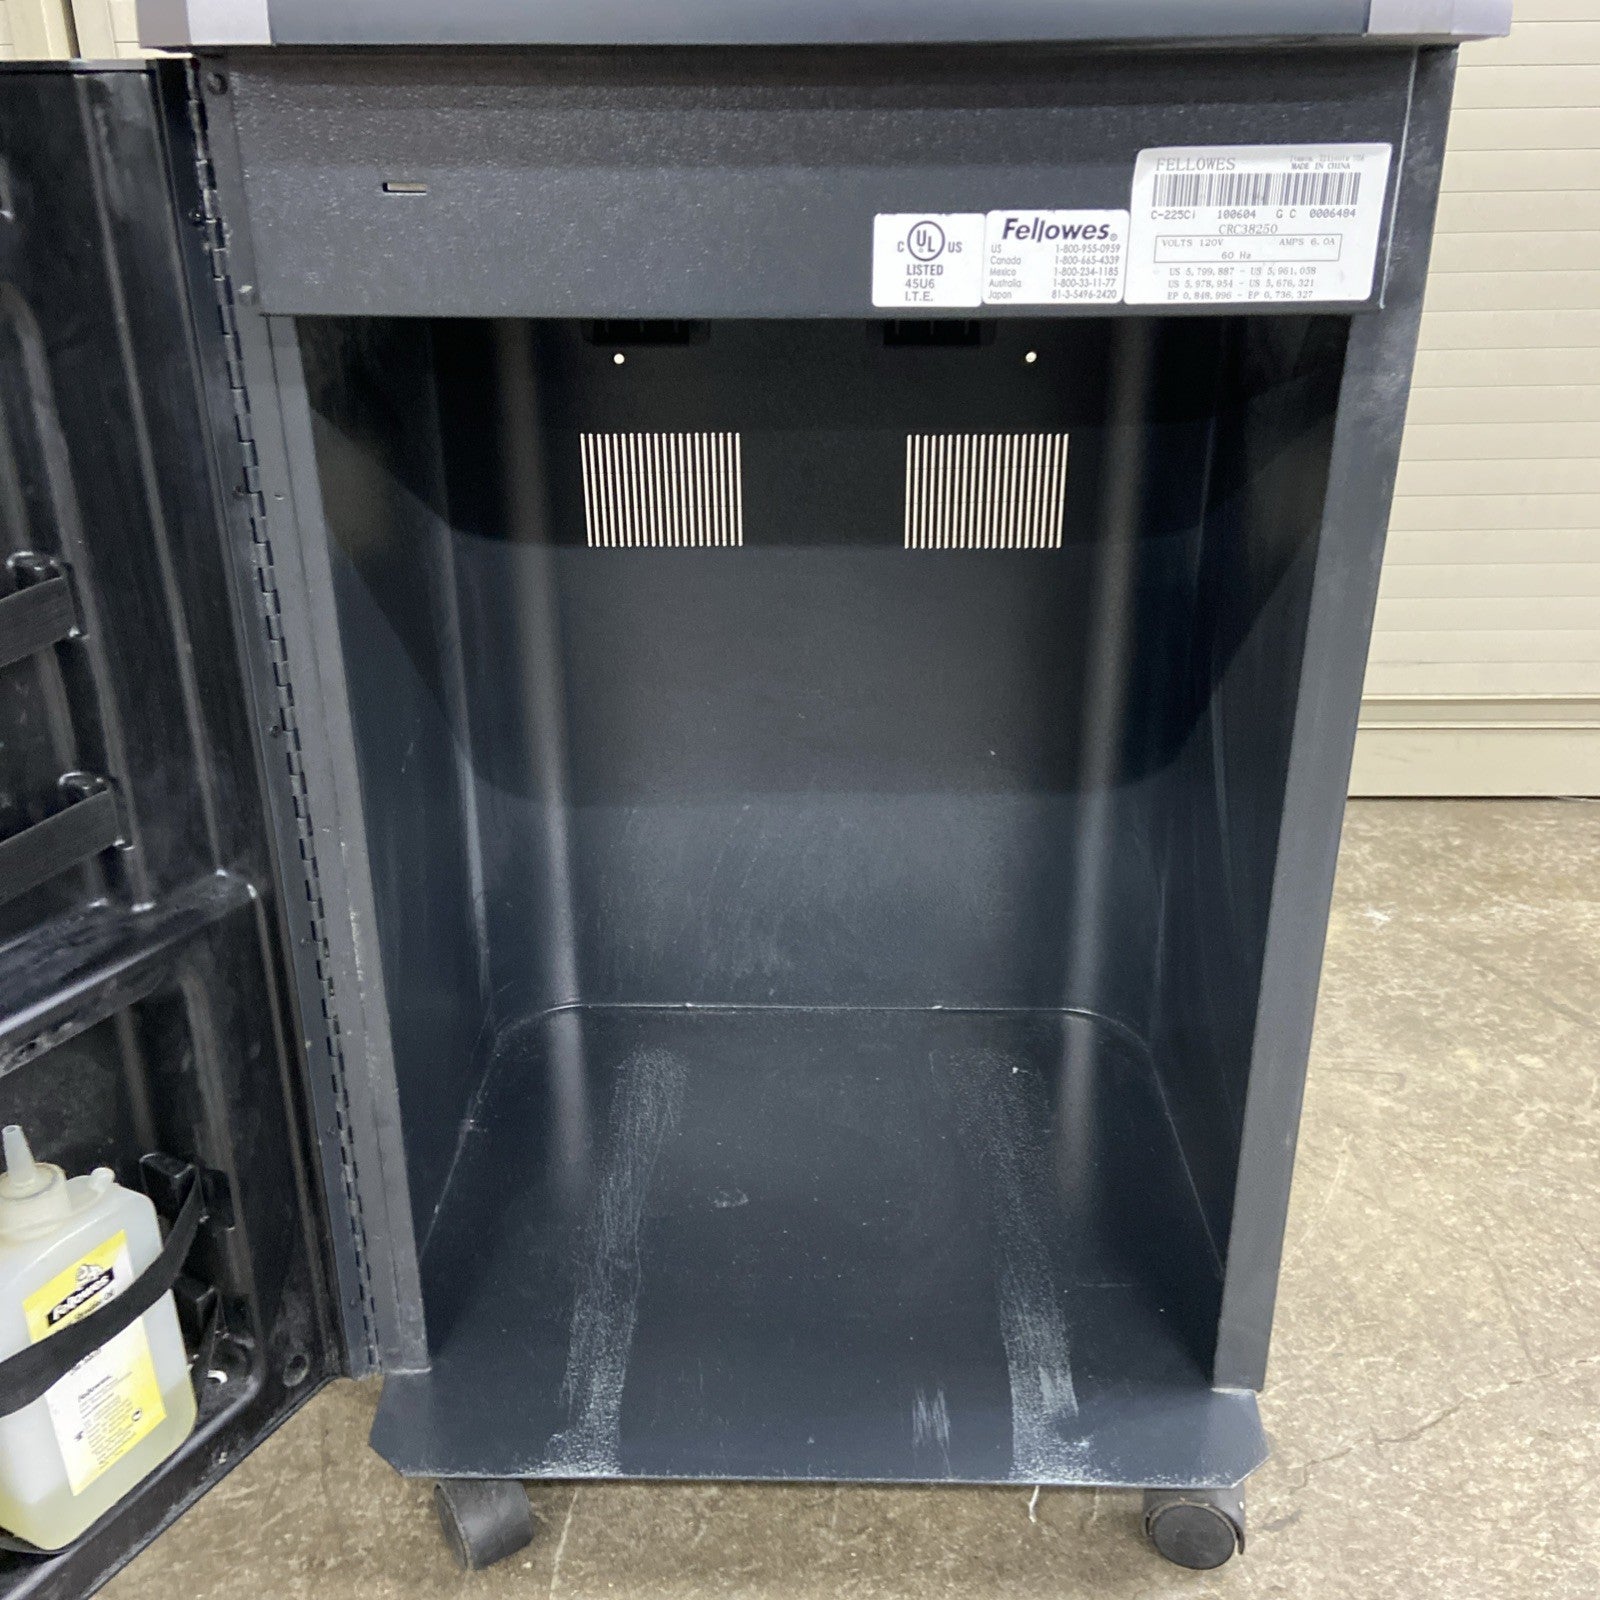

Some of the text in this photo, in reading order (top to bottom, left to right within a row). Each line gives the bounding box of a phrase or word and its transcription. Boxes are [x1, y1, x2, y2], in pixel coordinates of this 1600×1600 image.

[1155, 157, 1236, 172] FELLOWES
[1291, 162, 1351, 170] MADE IN CHINA
[1217, 209, 1257, 220] 100604
[1275, 209, 1284, 219] G
[1289, 209, 1297, 219] C
[1002, 217, 1111, 243] Fellowes
[1218, 223, 1279, 235] CRC38250
[896, 229, 963, 253] C UL US
[1162, 238, 1193, 247] VOLTS
[1199, 238, 1224, 247] 120V
[1279, 237, 1305, 246] AMPS
[990, 243, 1121, 253] US 1-800-955-0959
[989, 255, 1120, 265] Canada 1-800-665-4339
[1221, 251, 1252, 260] 60 Hz
[906, 264, 944, 276] LISTED
[989, 267, 1119, 276] Mexico 1-800-234-1185
[1169, 267, 1181, 276] US
[1250, 267, 1262, 276] US
[905, 278, 935, 289] 45U6
[988, 278, 1116, 288] Australia 1-800-33-11-77
[1168, 280, 1180, 289] US
[1249, 279, 1261, 288] US
[905, 291, 934, 302] I.T.E.
[988, 289, 1118, 300] Japan 81-3-5496-2420
[1167, 291, 1179, 300] EP
[1248, 291, 1260, 300] EP
